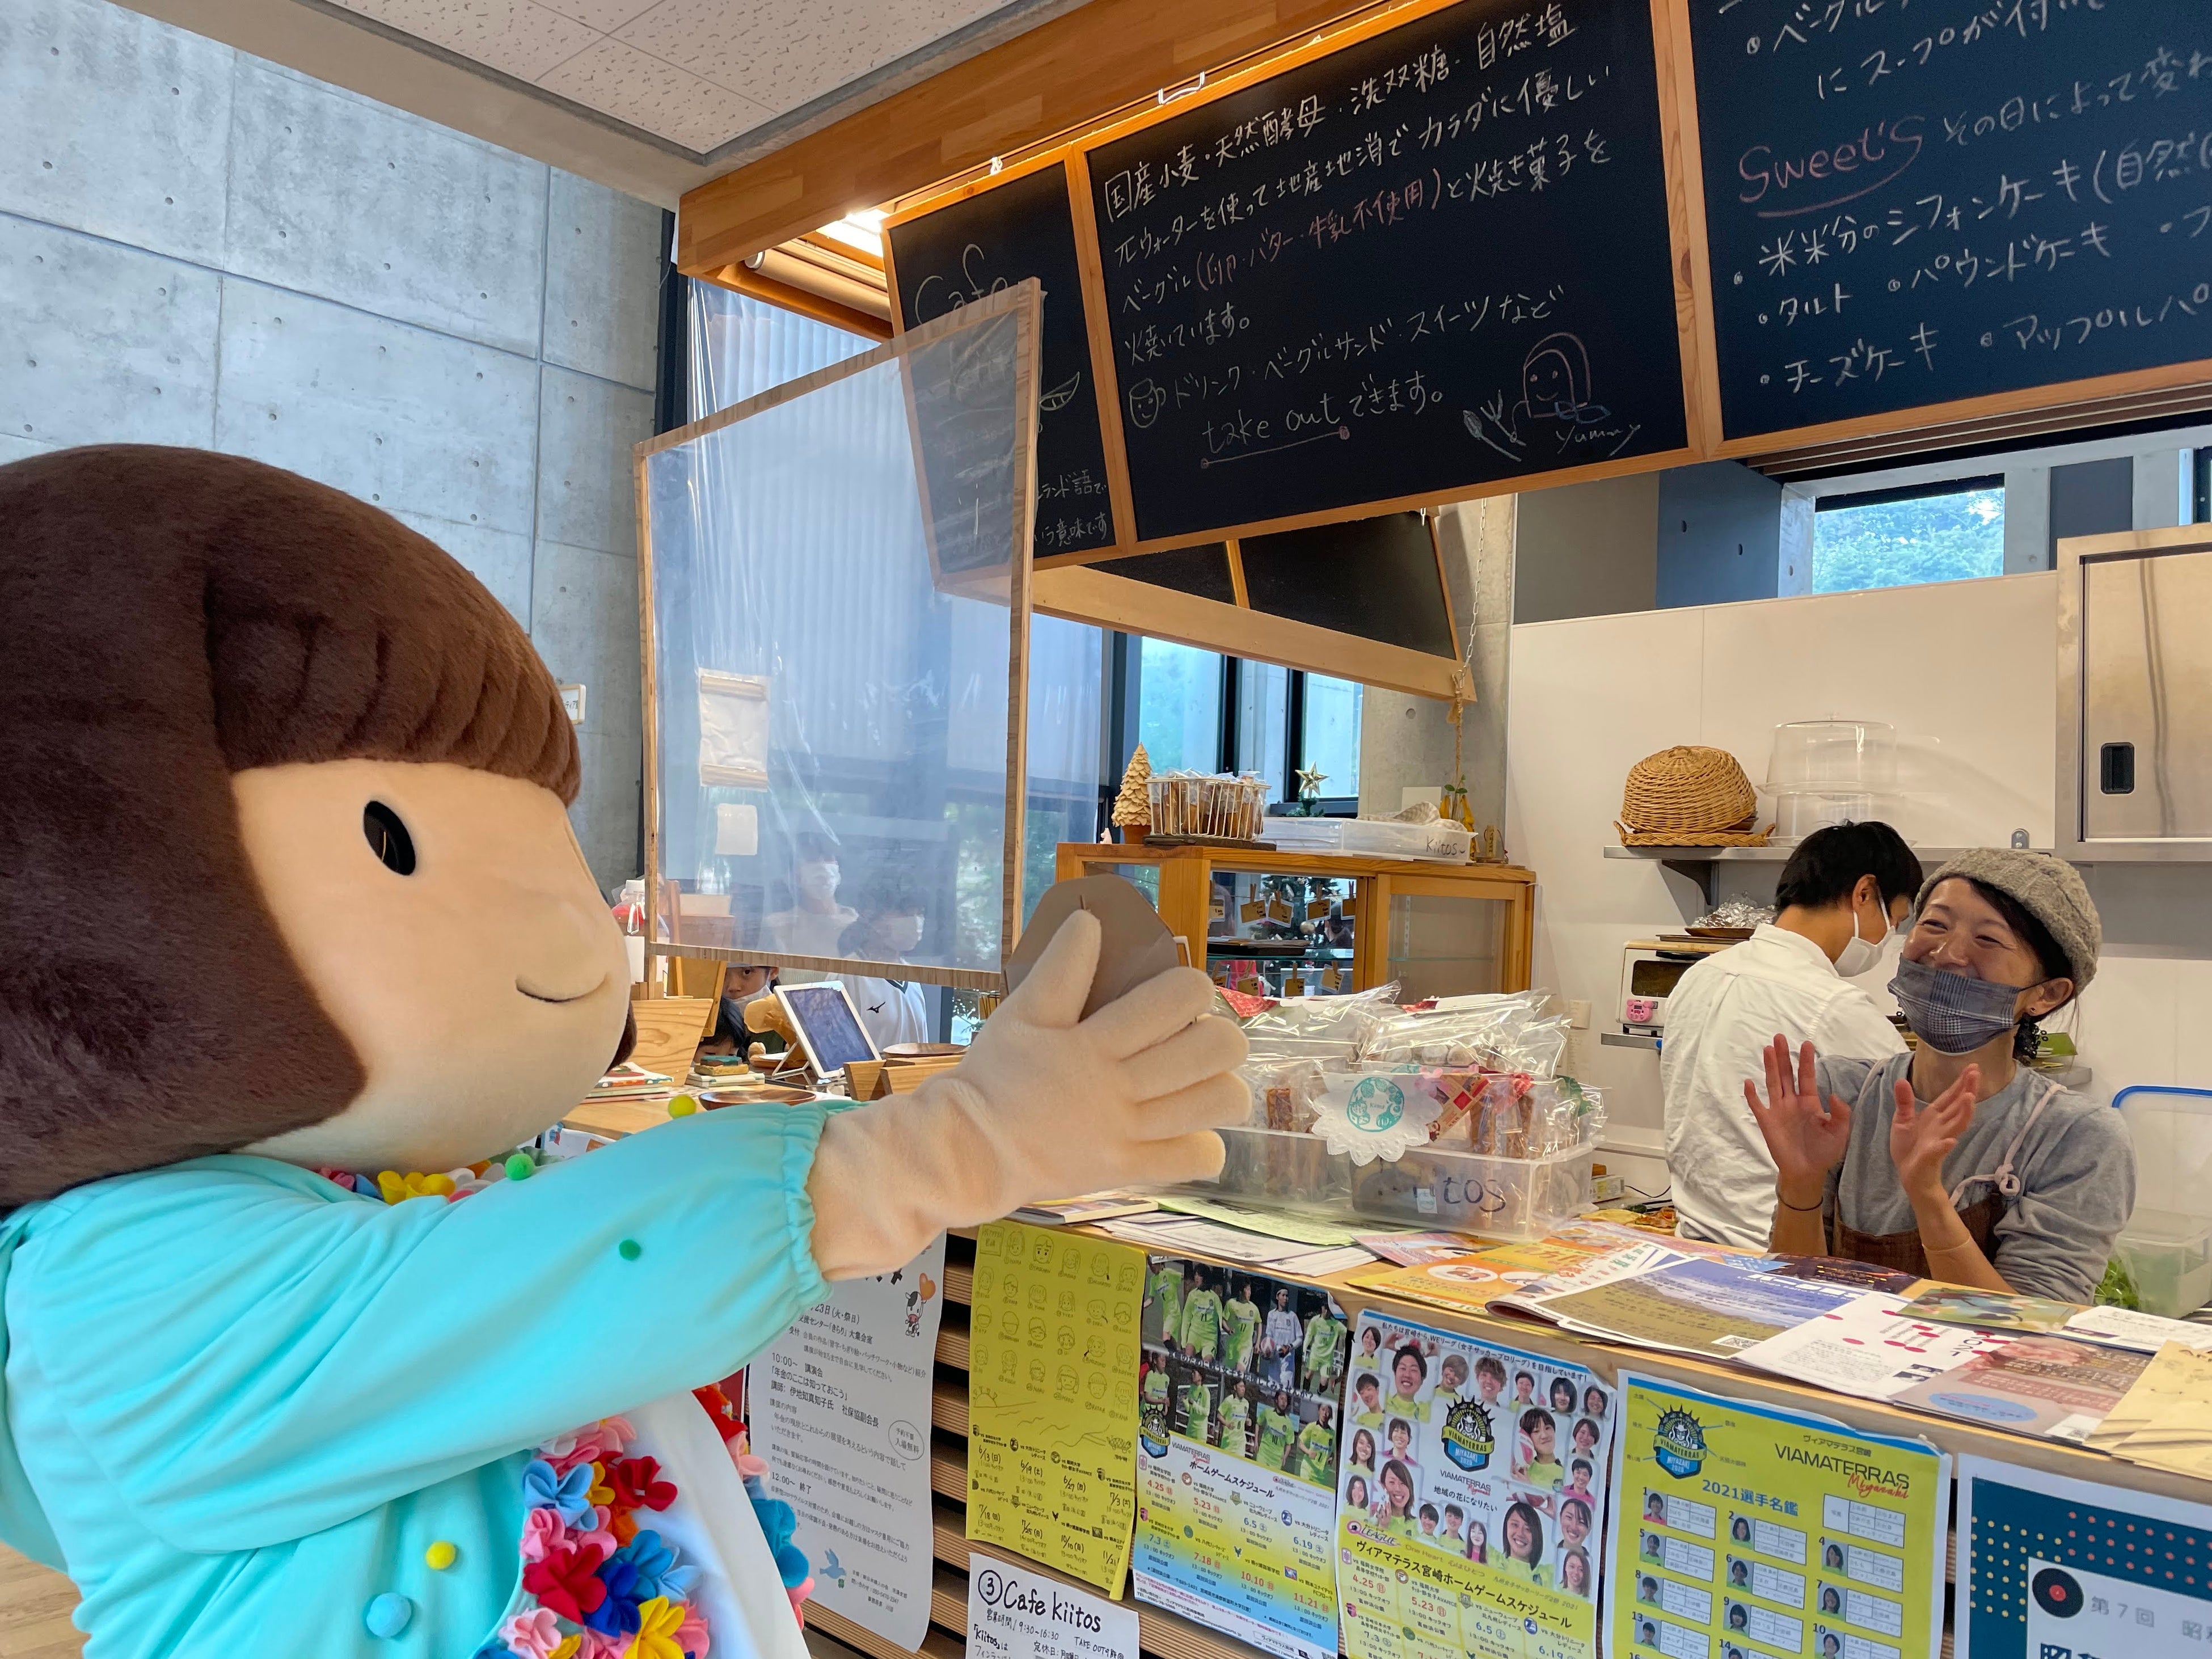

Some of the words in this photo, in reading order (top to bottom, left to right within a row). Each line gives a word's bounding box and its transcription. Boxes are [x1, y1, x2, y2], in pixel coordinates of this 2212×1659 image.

[1779, 283, 1853, 326] タルト
[1912, 222, 2112, 288] パウンドケーキ
[1124, 301, 1251, 367] 焼いています。
[1784, 322, 1940, 394] チーズケーキ
[1203, 407, 1270, 453] take
[1286, 391, 1345, 432] out
[1349, 370, 1444, 419] できます。
[805, 1363, 823, 1377] 講演会
[895, 1438, 919, 1454] 入場無料
[1660, 1438, 1699, 1459] VIAMATERRAS
[1803, 1435, 1872, 1457] ヴィアマテラス宮崎
[1775, 1443, 1910, 1489] VIAMATERRAS
[1190, 1461, 1275, 1498] ホームゲームスケジュール
[1440, 1470, 1491, 1492] VIAMATERRAS
[800, 1482, 811, 1494] 終了
[1643, 1487, 1648, 1496] 1
[1434, 1485, 1498, 1513] 地域の花になりたい
[1702, 1479, 1799, 1517] 2021選手名鑑
[1729, 1510, 1734, 1519] 2
[1639, 1529, 1645, 1537] 5
[1819, 1536, 1825, 1546] 4
[1726, 1554, 1732, 1563] 6
[1353, 1574, 1374, 1588] 4.25
[1635, 1570, 1641, 1578] 8
[1356, 1540, 1573, 1629] ヴィアマテラス宮崎ホームゲームスケジュール
[1816, 1580, 1823, 1589] 7
[1412, 1597, 1434, 1611] 5.23
[1724, 1597, 1729, 1606] 9
[1632, 1611, 1643, 1622] 13
[1476, 1622, 1492, 1634] 6.5
[1813, 1623, 1826, 1634] 10
[1364, 1631, 1379, 1642] 7.3
[1719, 1639, 1730, 1649] 14
